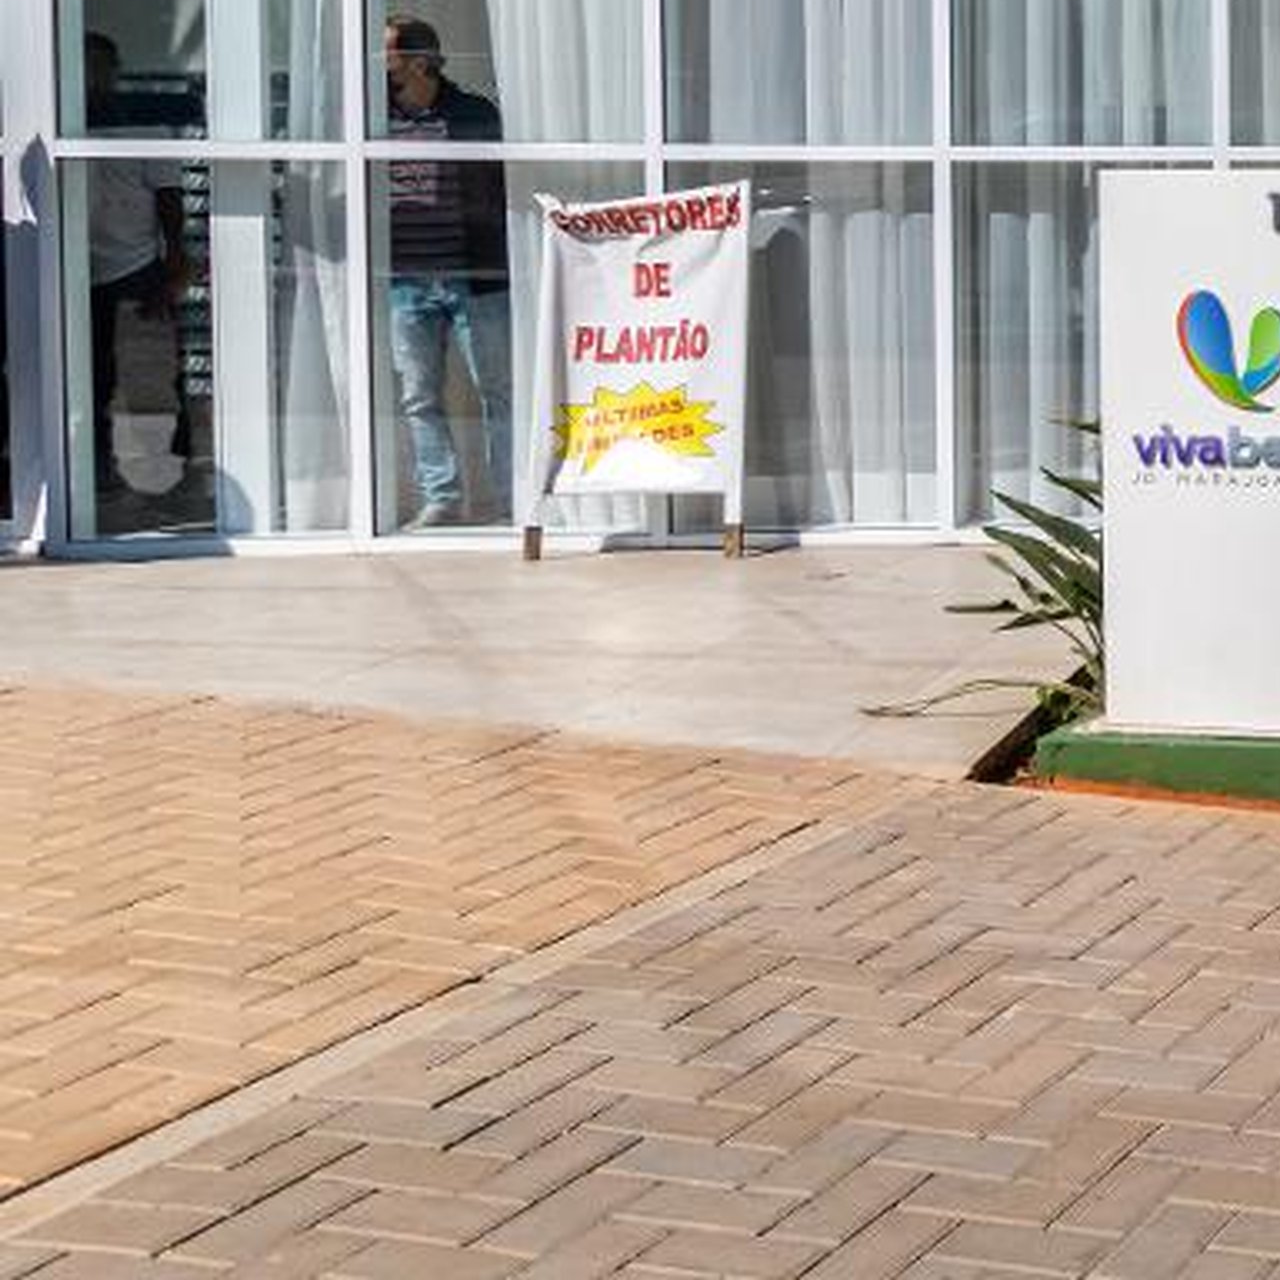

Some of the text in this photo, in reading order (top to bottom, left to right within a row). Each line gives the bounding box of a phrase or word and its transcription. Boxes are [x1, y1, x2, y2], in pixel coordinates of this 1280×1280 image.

[549, 187, 741, 236] CORRETORES
[633, 263, 672, 297] DE
[574, 320, 710, 363] PLANTÃO
